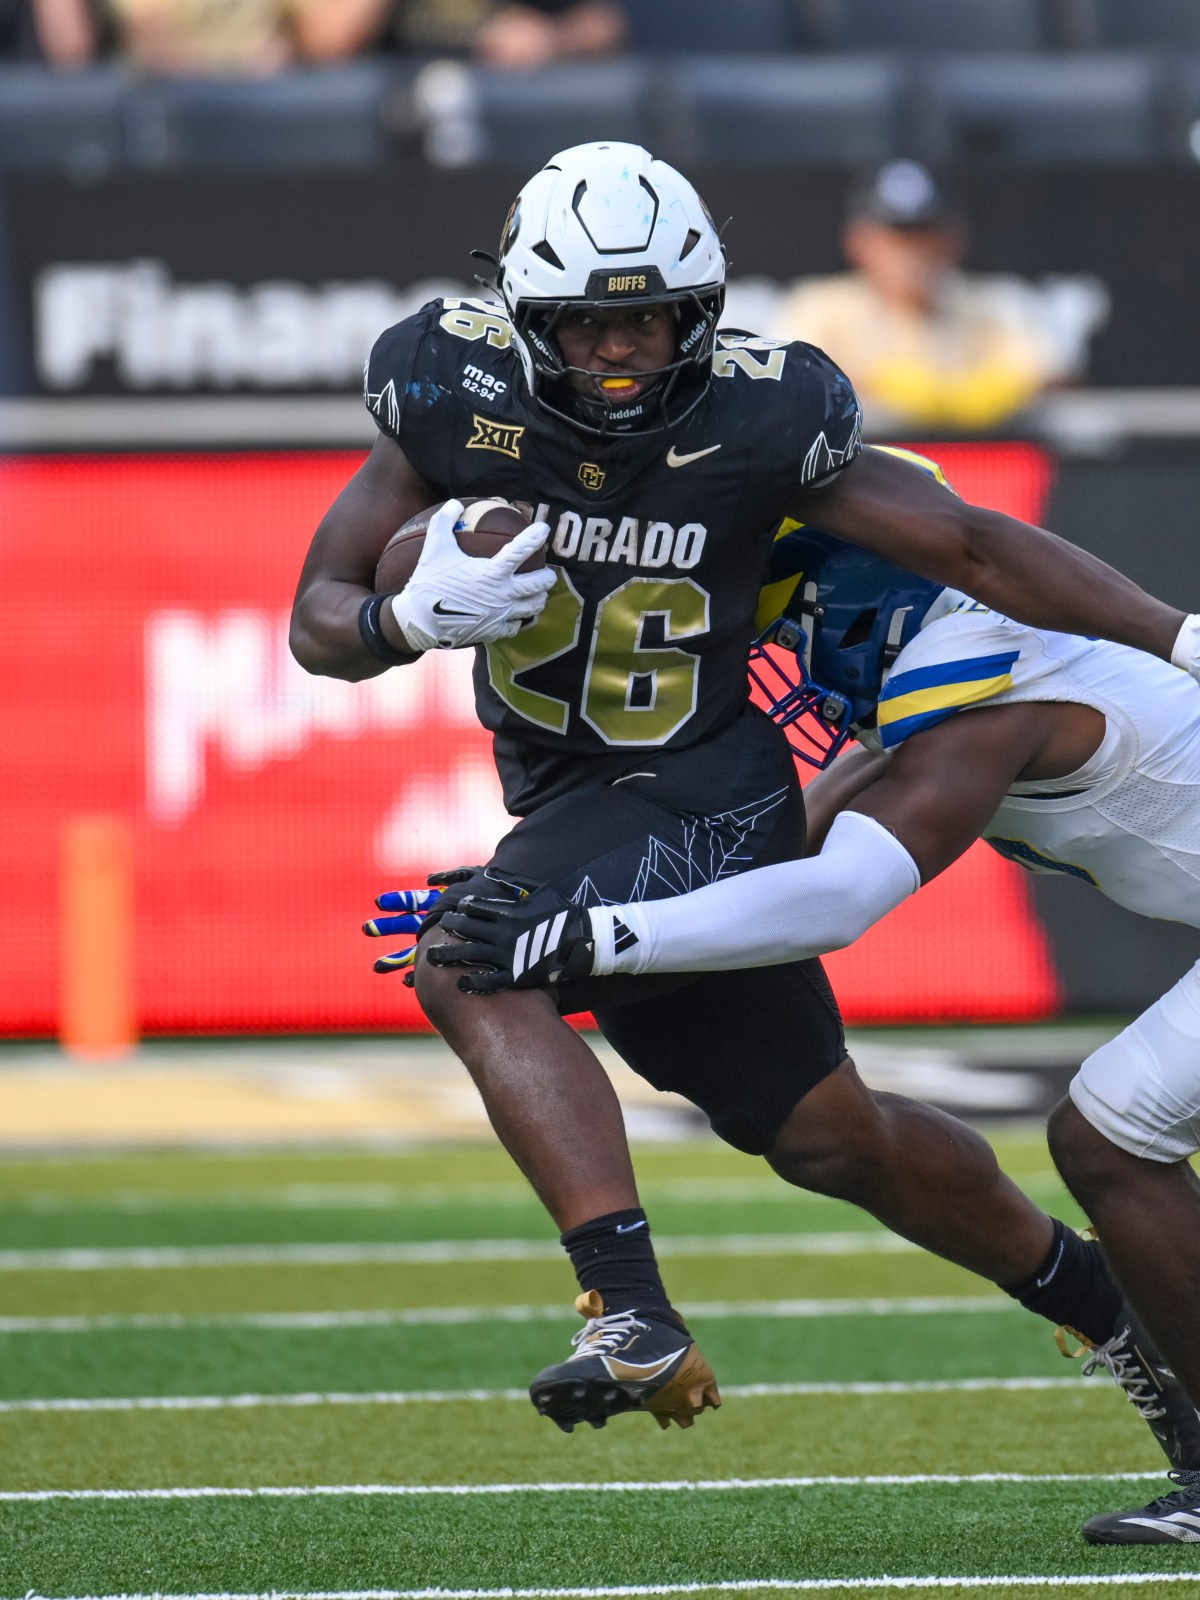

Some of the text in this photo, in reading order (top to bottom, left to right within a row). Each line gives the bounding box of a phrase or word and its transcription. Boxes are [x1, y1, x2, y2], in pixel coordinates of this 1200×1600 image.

[607, 275, 647, 292] BUFFS
[462, 378, 497, 402] 82-94
[463, 363, 507, 393] mac
[465, 413, 526, 460] XII
[578, 462, 606, 491] CU
[508, 500, 708, 570] ORADO
[485, 563, 711, 746] 26
